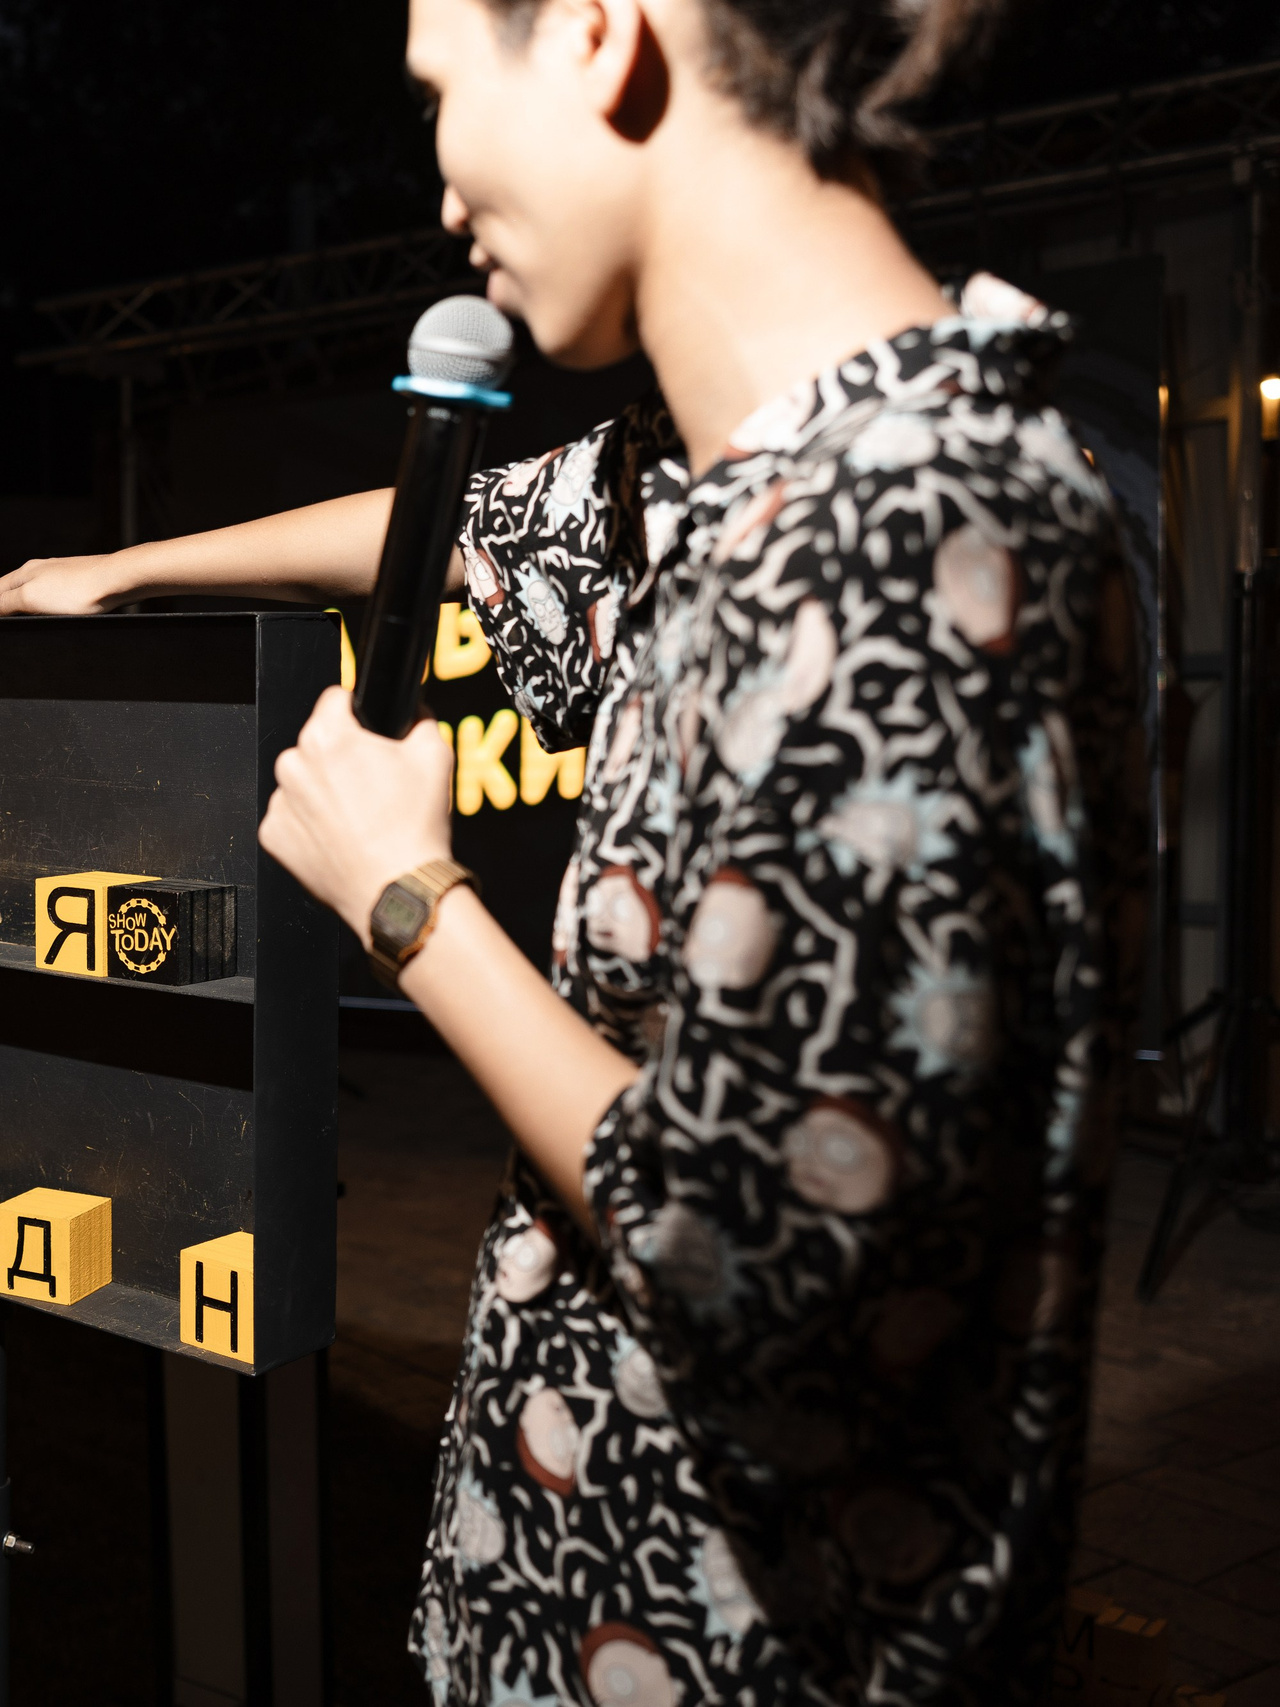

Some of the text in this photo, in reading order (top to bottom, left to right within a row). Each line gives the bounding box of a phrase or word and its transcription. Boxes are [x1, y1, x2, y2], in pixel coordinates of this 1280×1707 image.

[44, 886, 96, 971] Я
[108, 912, 147, 931] SHOW
[7, 1216, 57, 1298] Д
